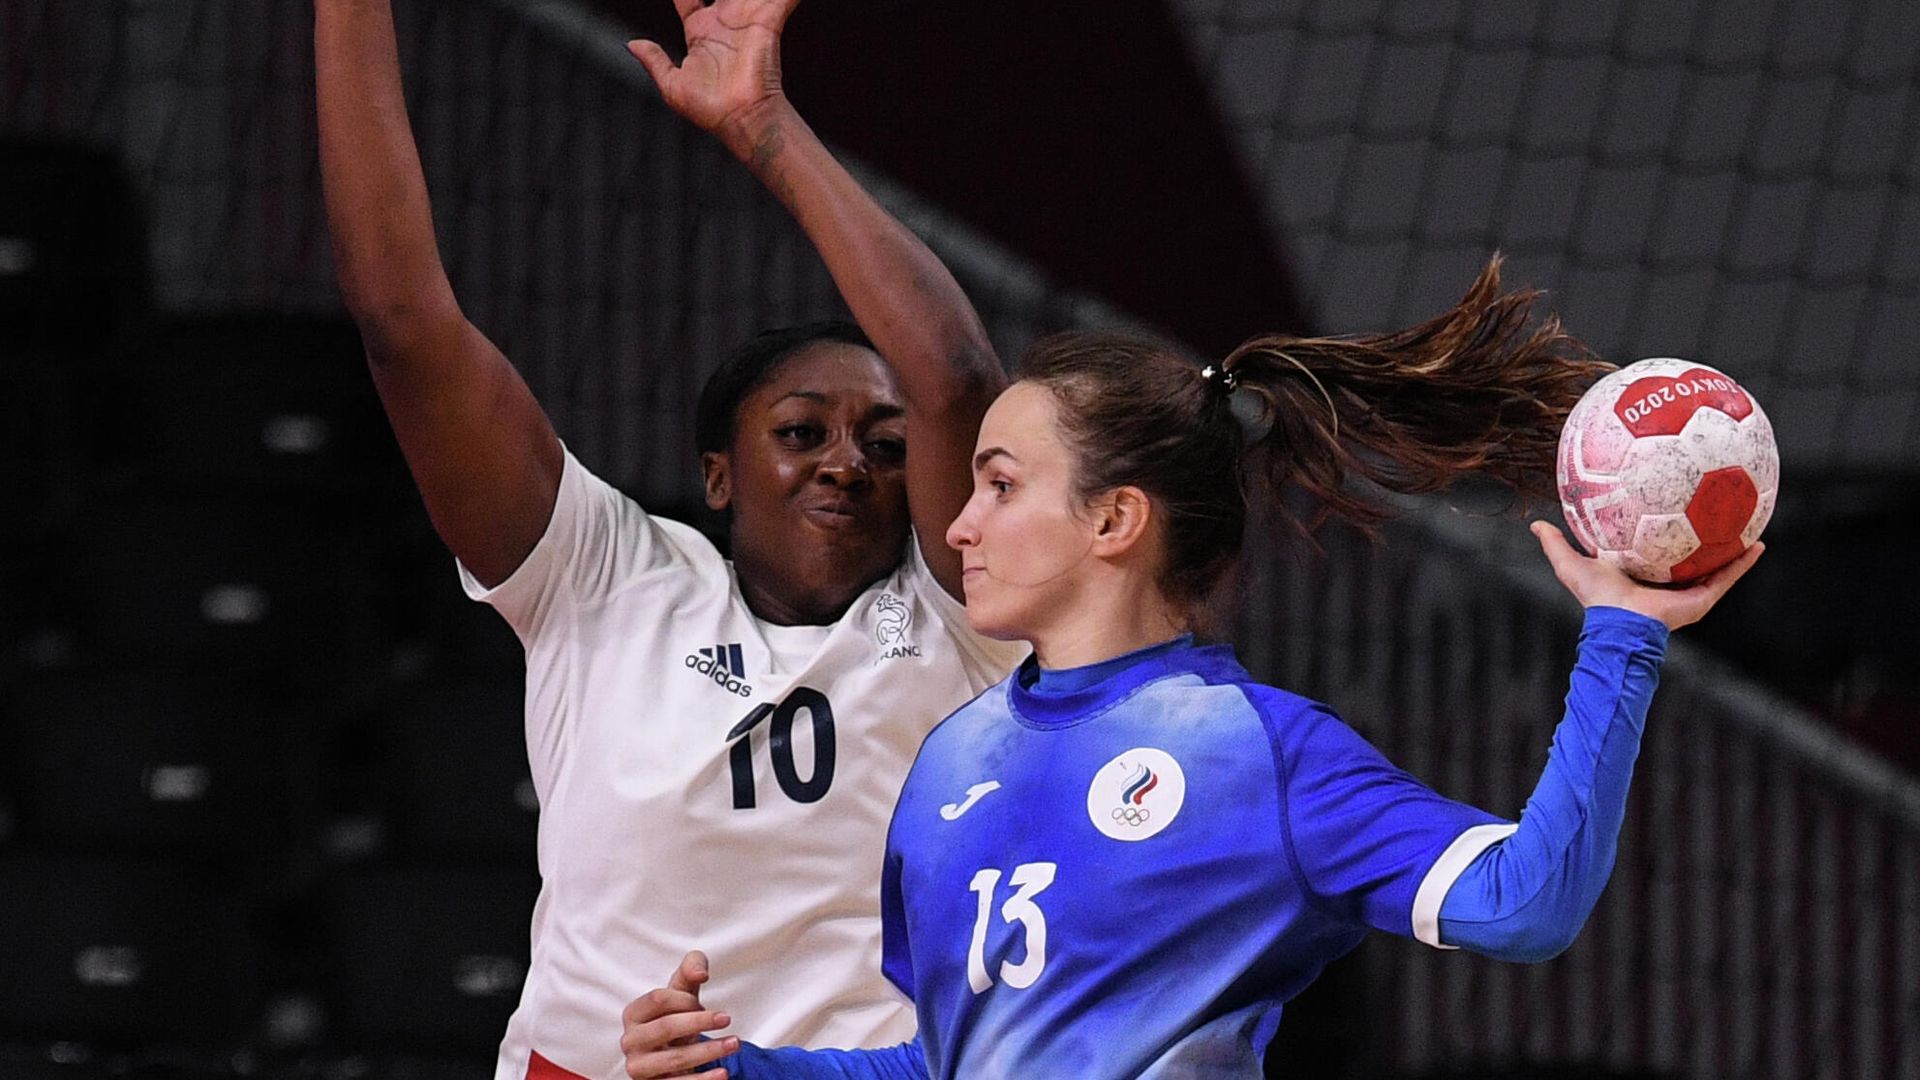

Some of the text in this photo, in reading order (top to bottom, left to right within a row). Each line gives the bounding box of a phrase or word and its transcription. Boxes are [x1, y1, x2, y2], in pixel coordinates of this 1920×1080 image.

[1624, 378, 1739, 424] TOKYO 2020
[685, 654, 752, 698] adidas
[725, 686, 836, 810] 10
[967, 862, 1057, 995] 13
